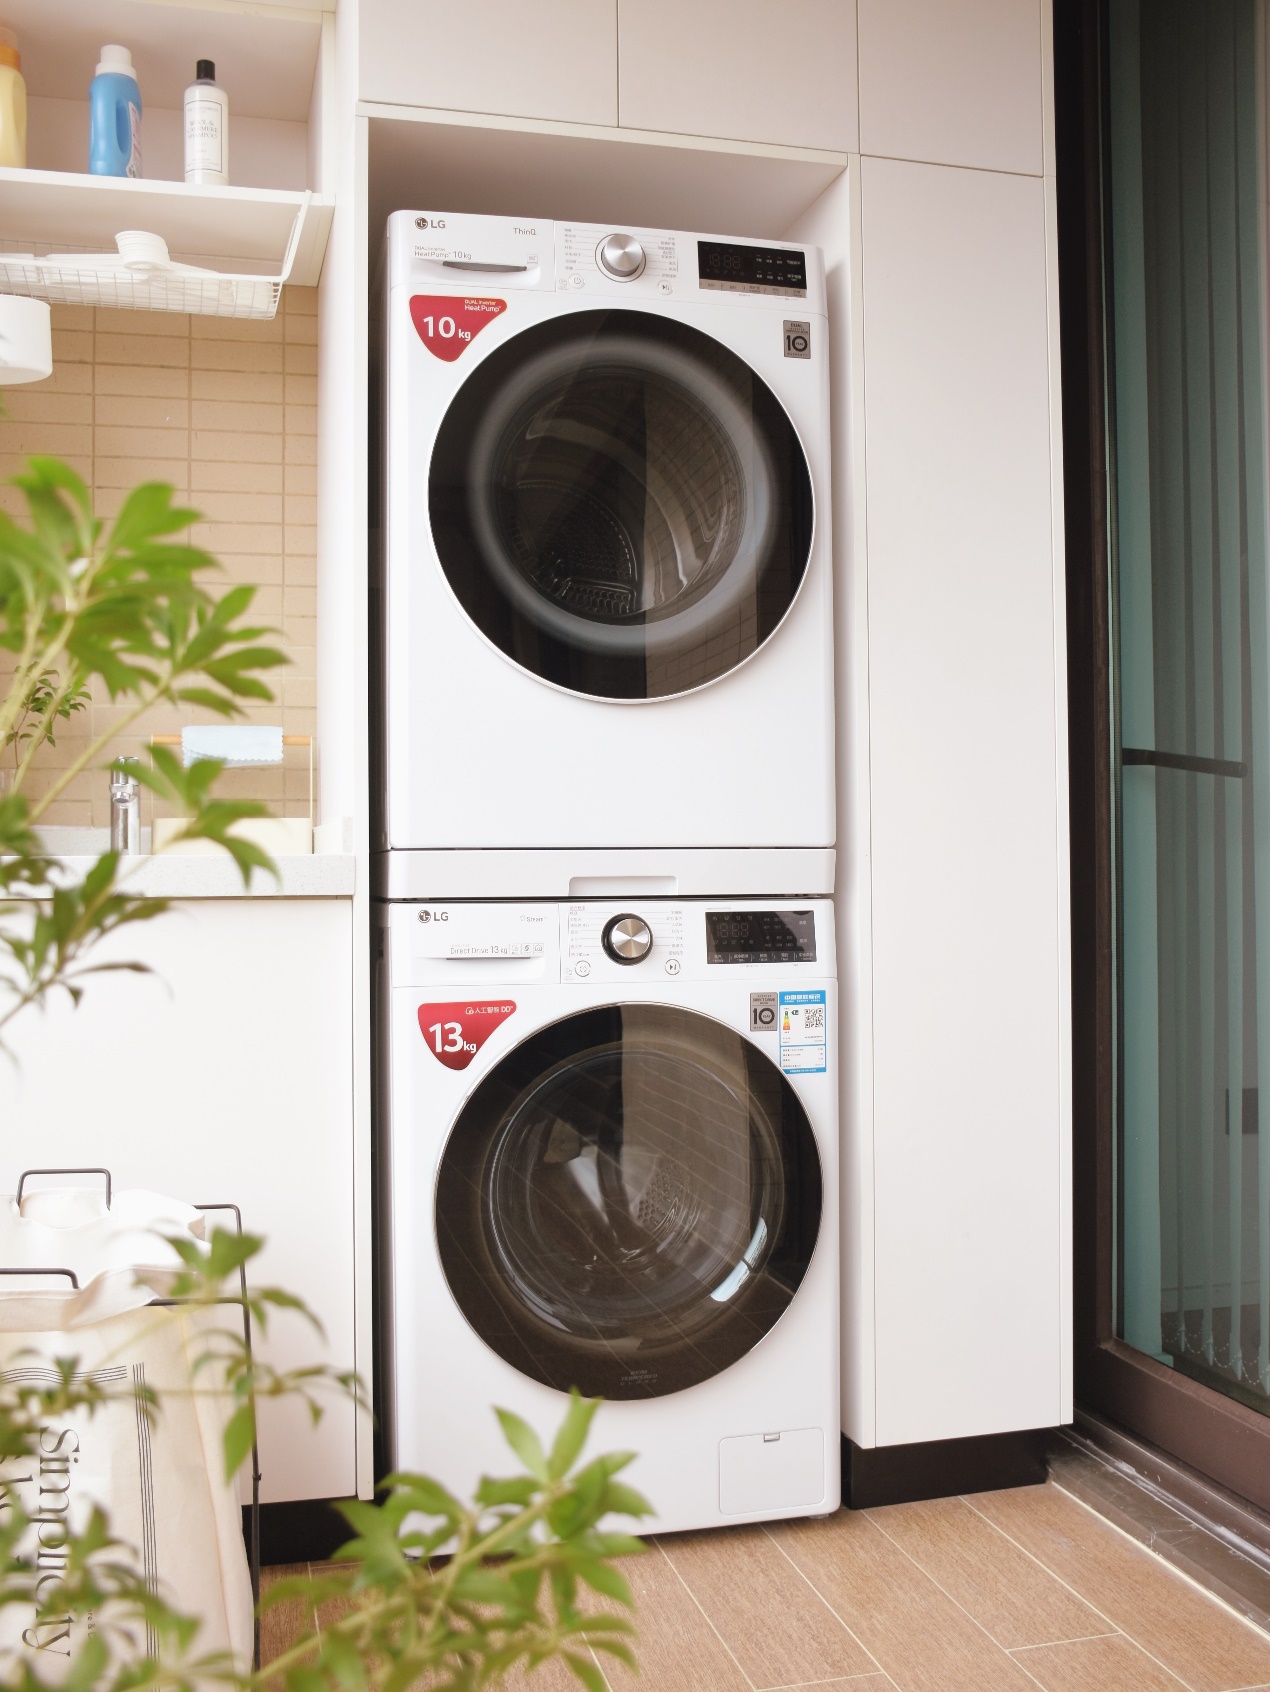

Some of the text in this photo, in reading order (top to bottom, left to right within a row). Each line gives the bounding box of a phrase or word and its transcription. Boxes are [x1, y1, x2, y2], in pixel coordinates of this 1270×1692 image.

[430, 220, 446, 229] LG
[513, 227, 537, 236] ThinQ
[423, 316, 471, 341] 10 kg
[786, 334, 808, 352] 10
[433, 911, 449, 921] LG
[450, 947, 470, 955] Direct
[753, 1007, 775, 1025] 10
